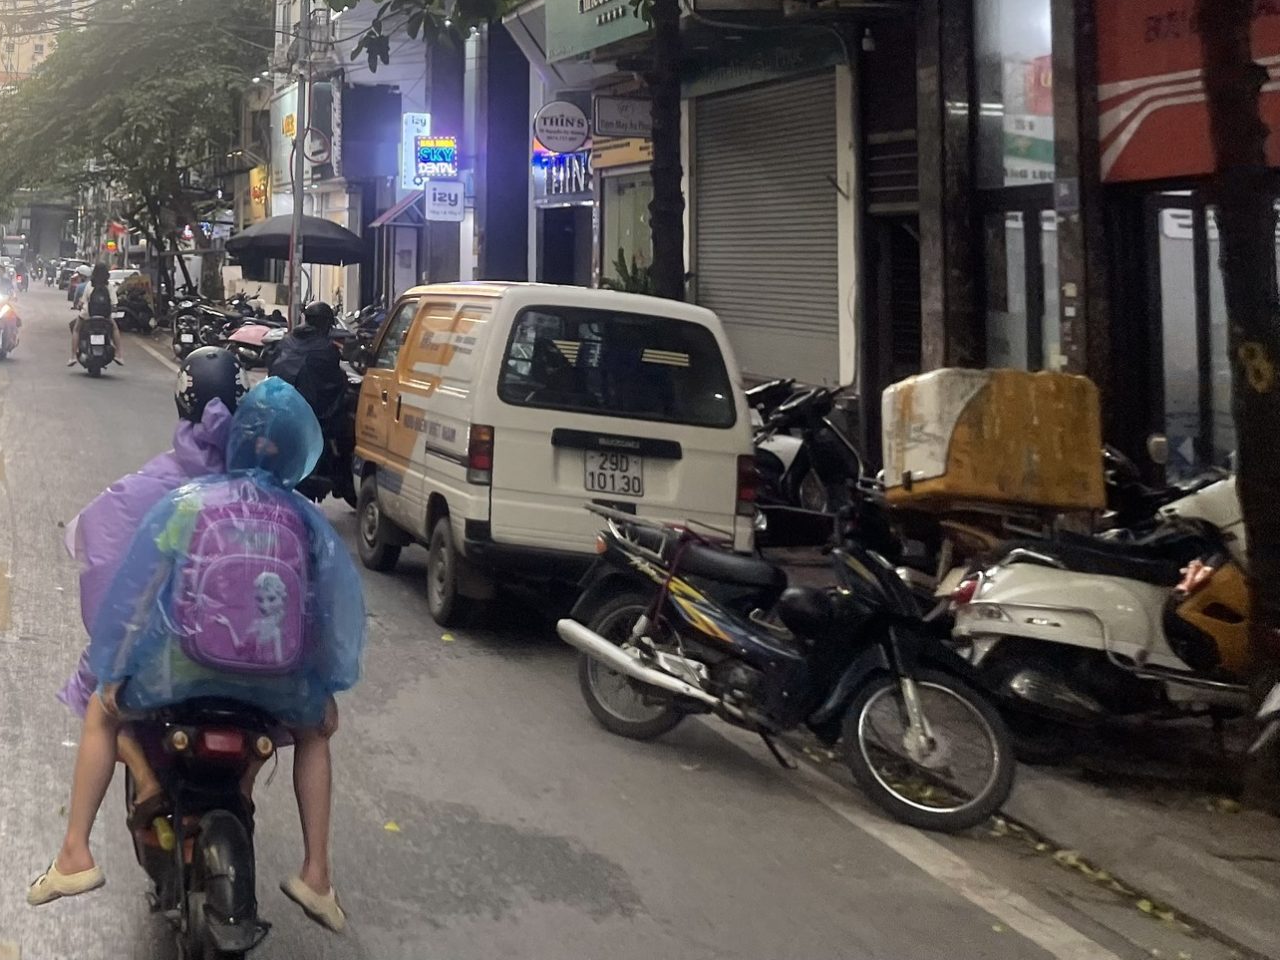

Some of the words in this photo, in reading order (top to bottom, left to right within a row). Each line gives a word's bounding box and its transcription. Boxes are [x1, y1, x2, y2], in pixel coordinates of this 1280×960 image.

[420, 148, 455, 162] SKY
[432, 187, 458, 207] izy
[599, 452, 629, 473] 29D
